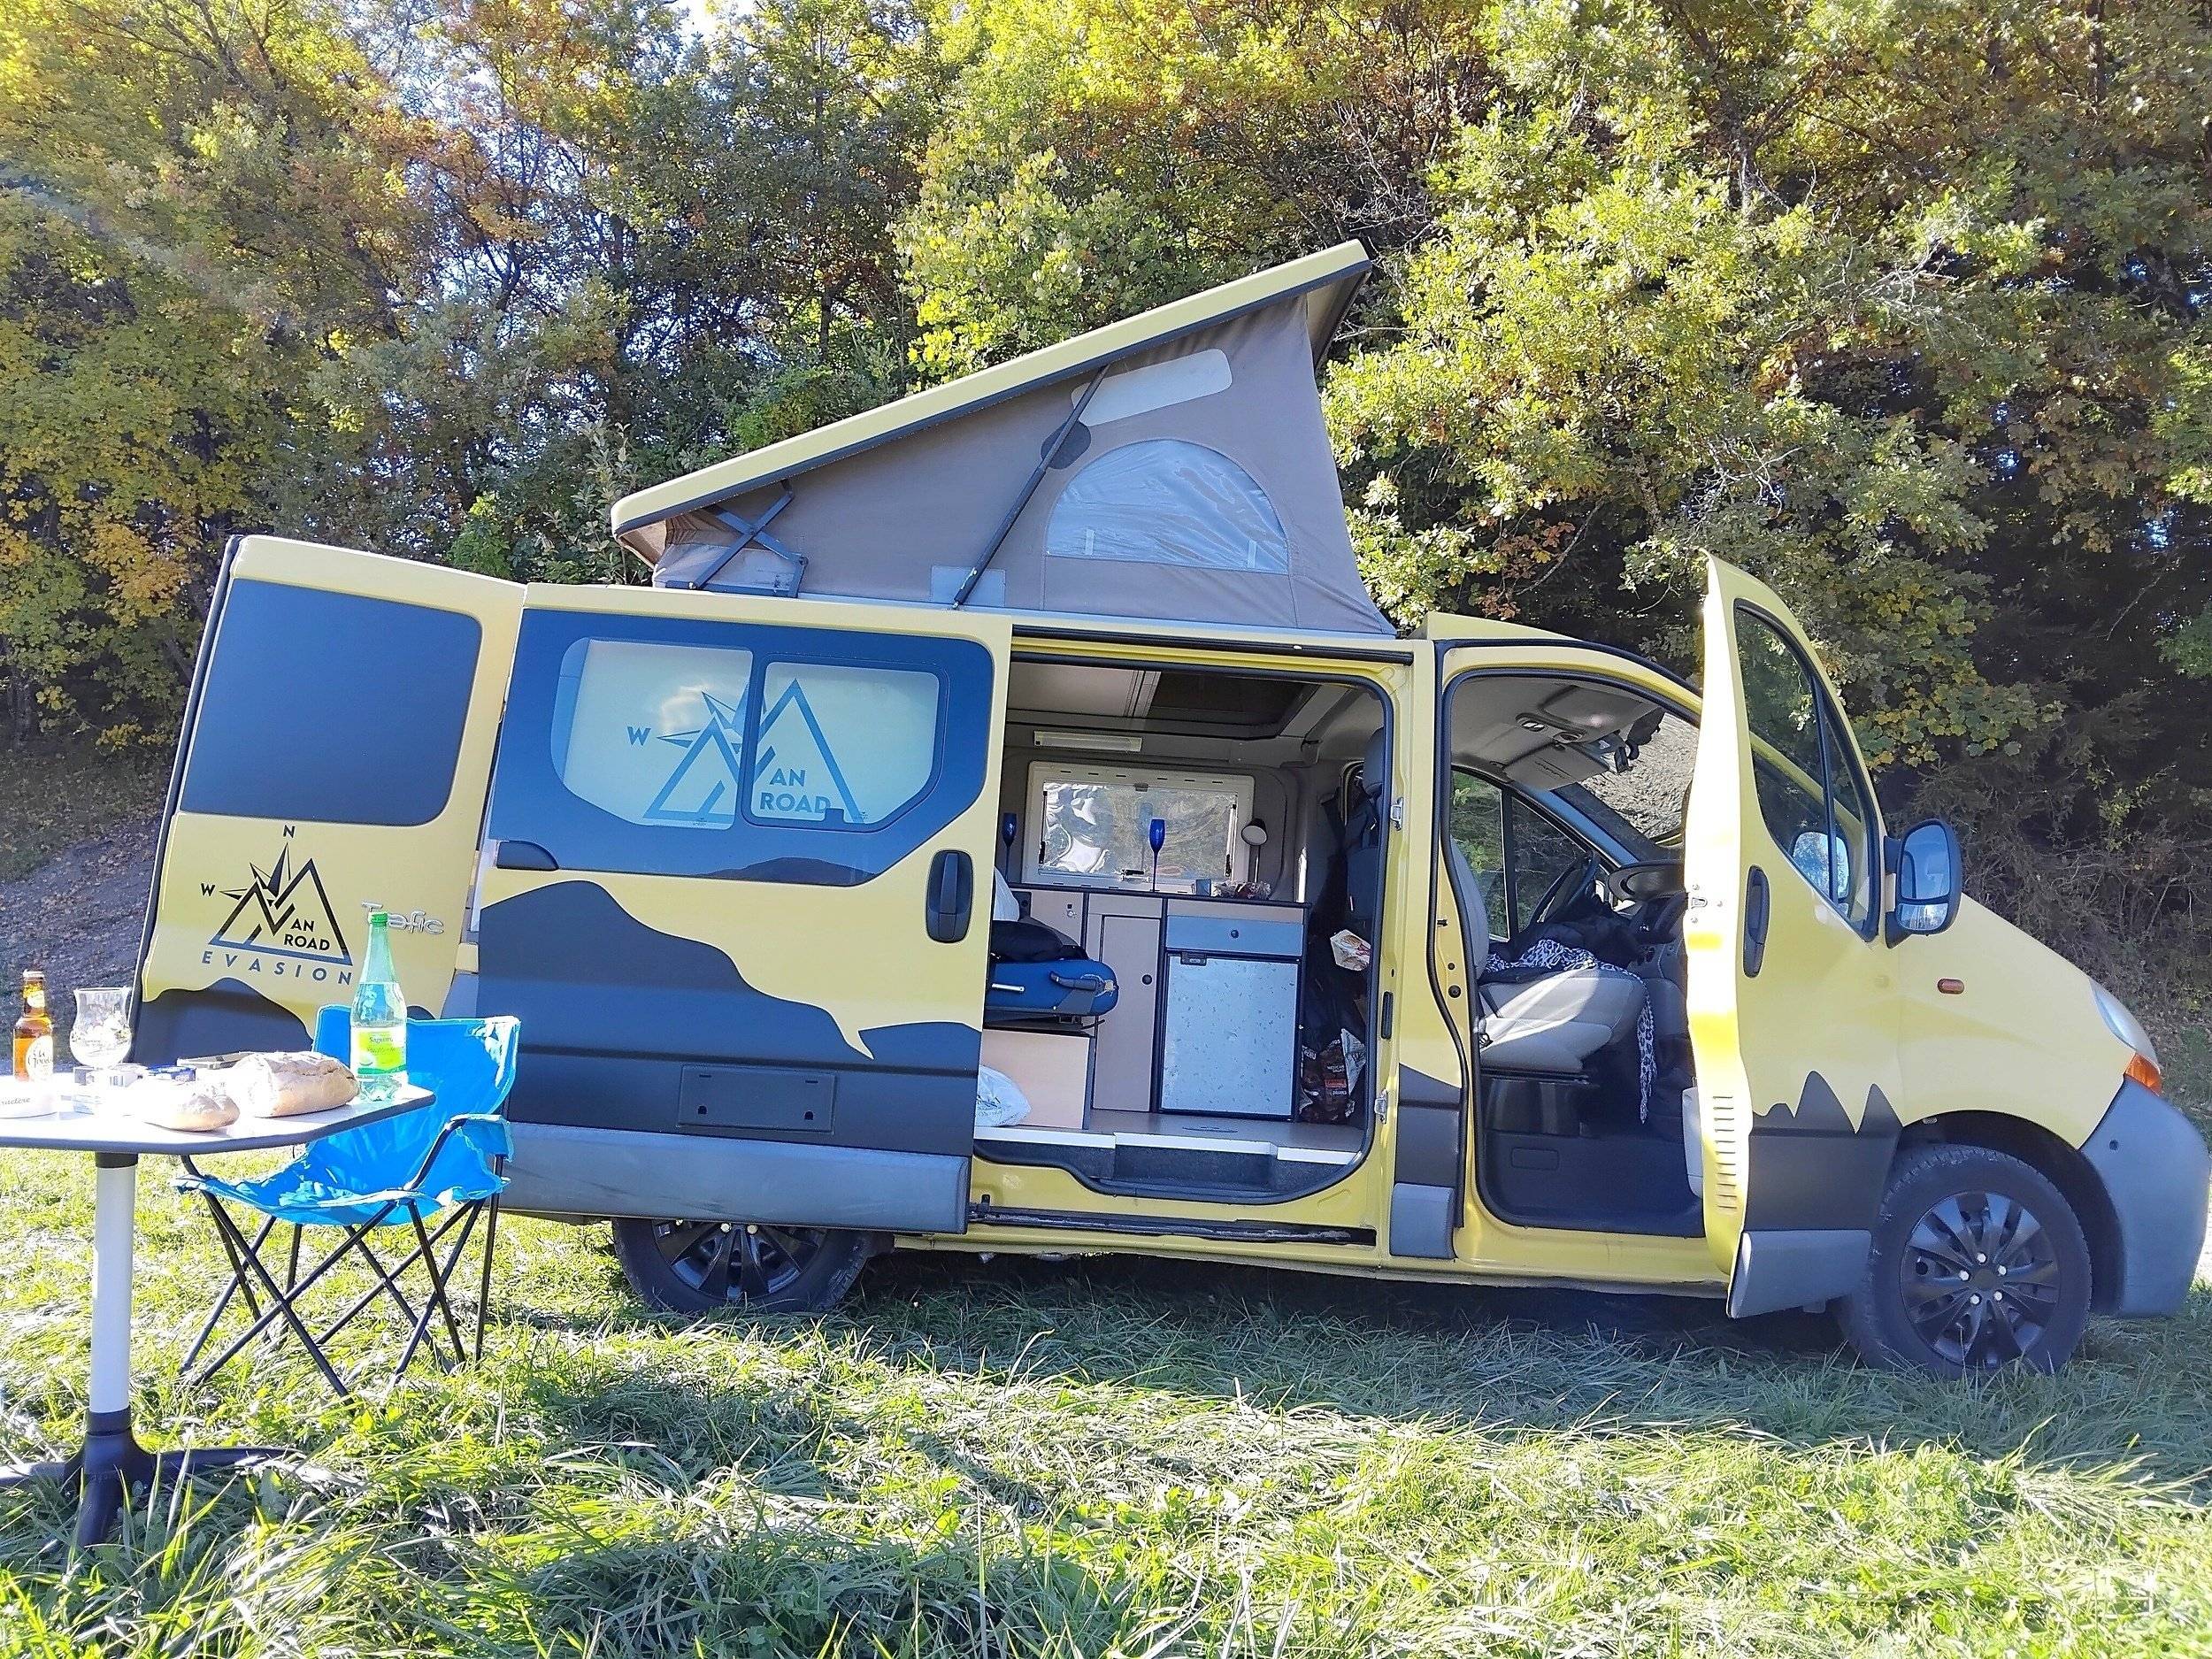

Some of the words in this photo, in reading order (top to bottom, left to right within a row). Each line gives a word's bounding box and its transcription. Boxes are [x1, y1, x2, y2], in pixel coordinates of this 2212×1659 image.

[626, 726, 651, 747] W
[759, 792, 832, 814] ROAD
[282, 825, 296, 839] N
[200, 883, 216, 897] W
[361, 901, 445, 934] Tafic
[284, 934, 331, 952] ROAD
[201, 950, 353, 986] EVASION
